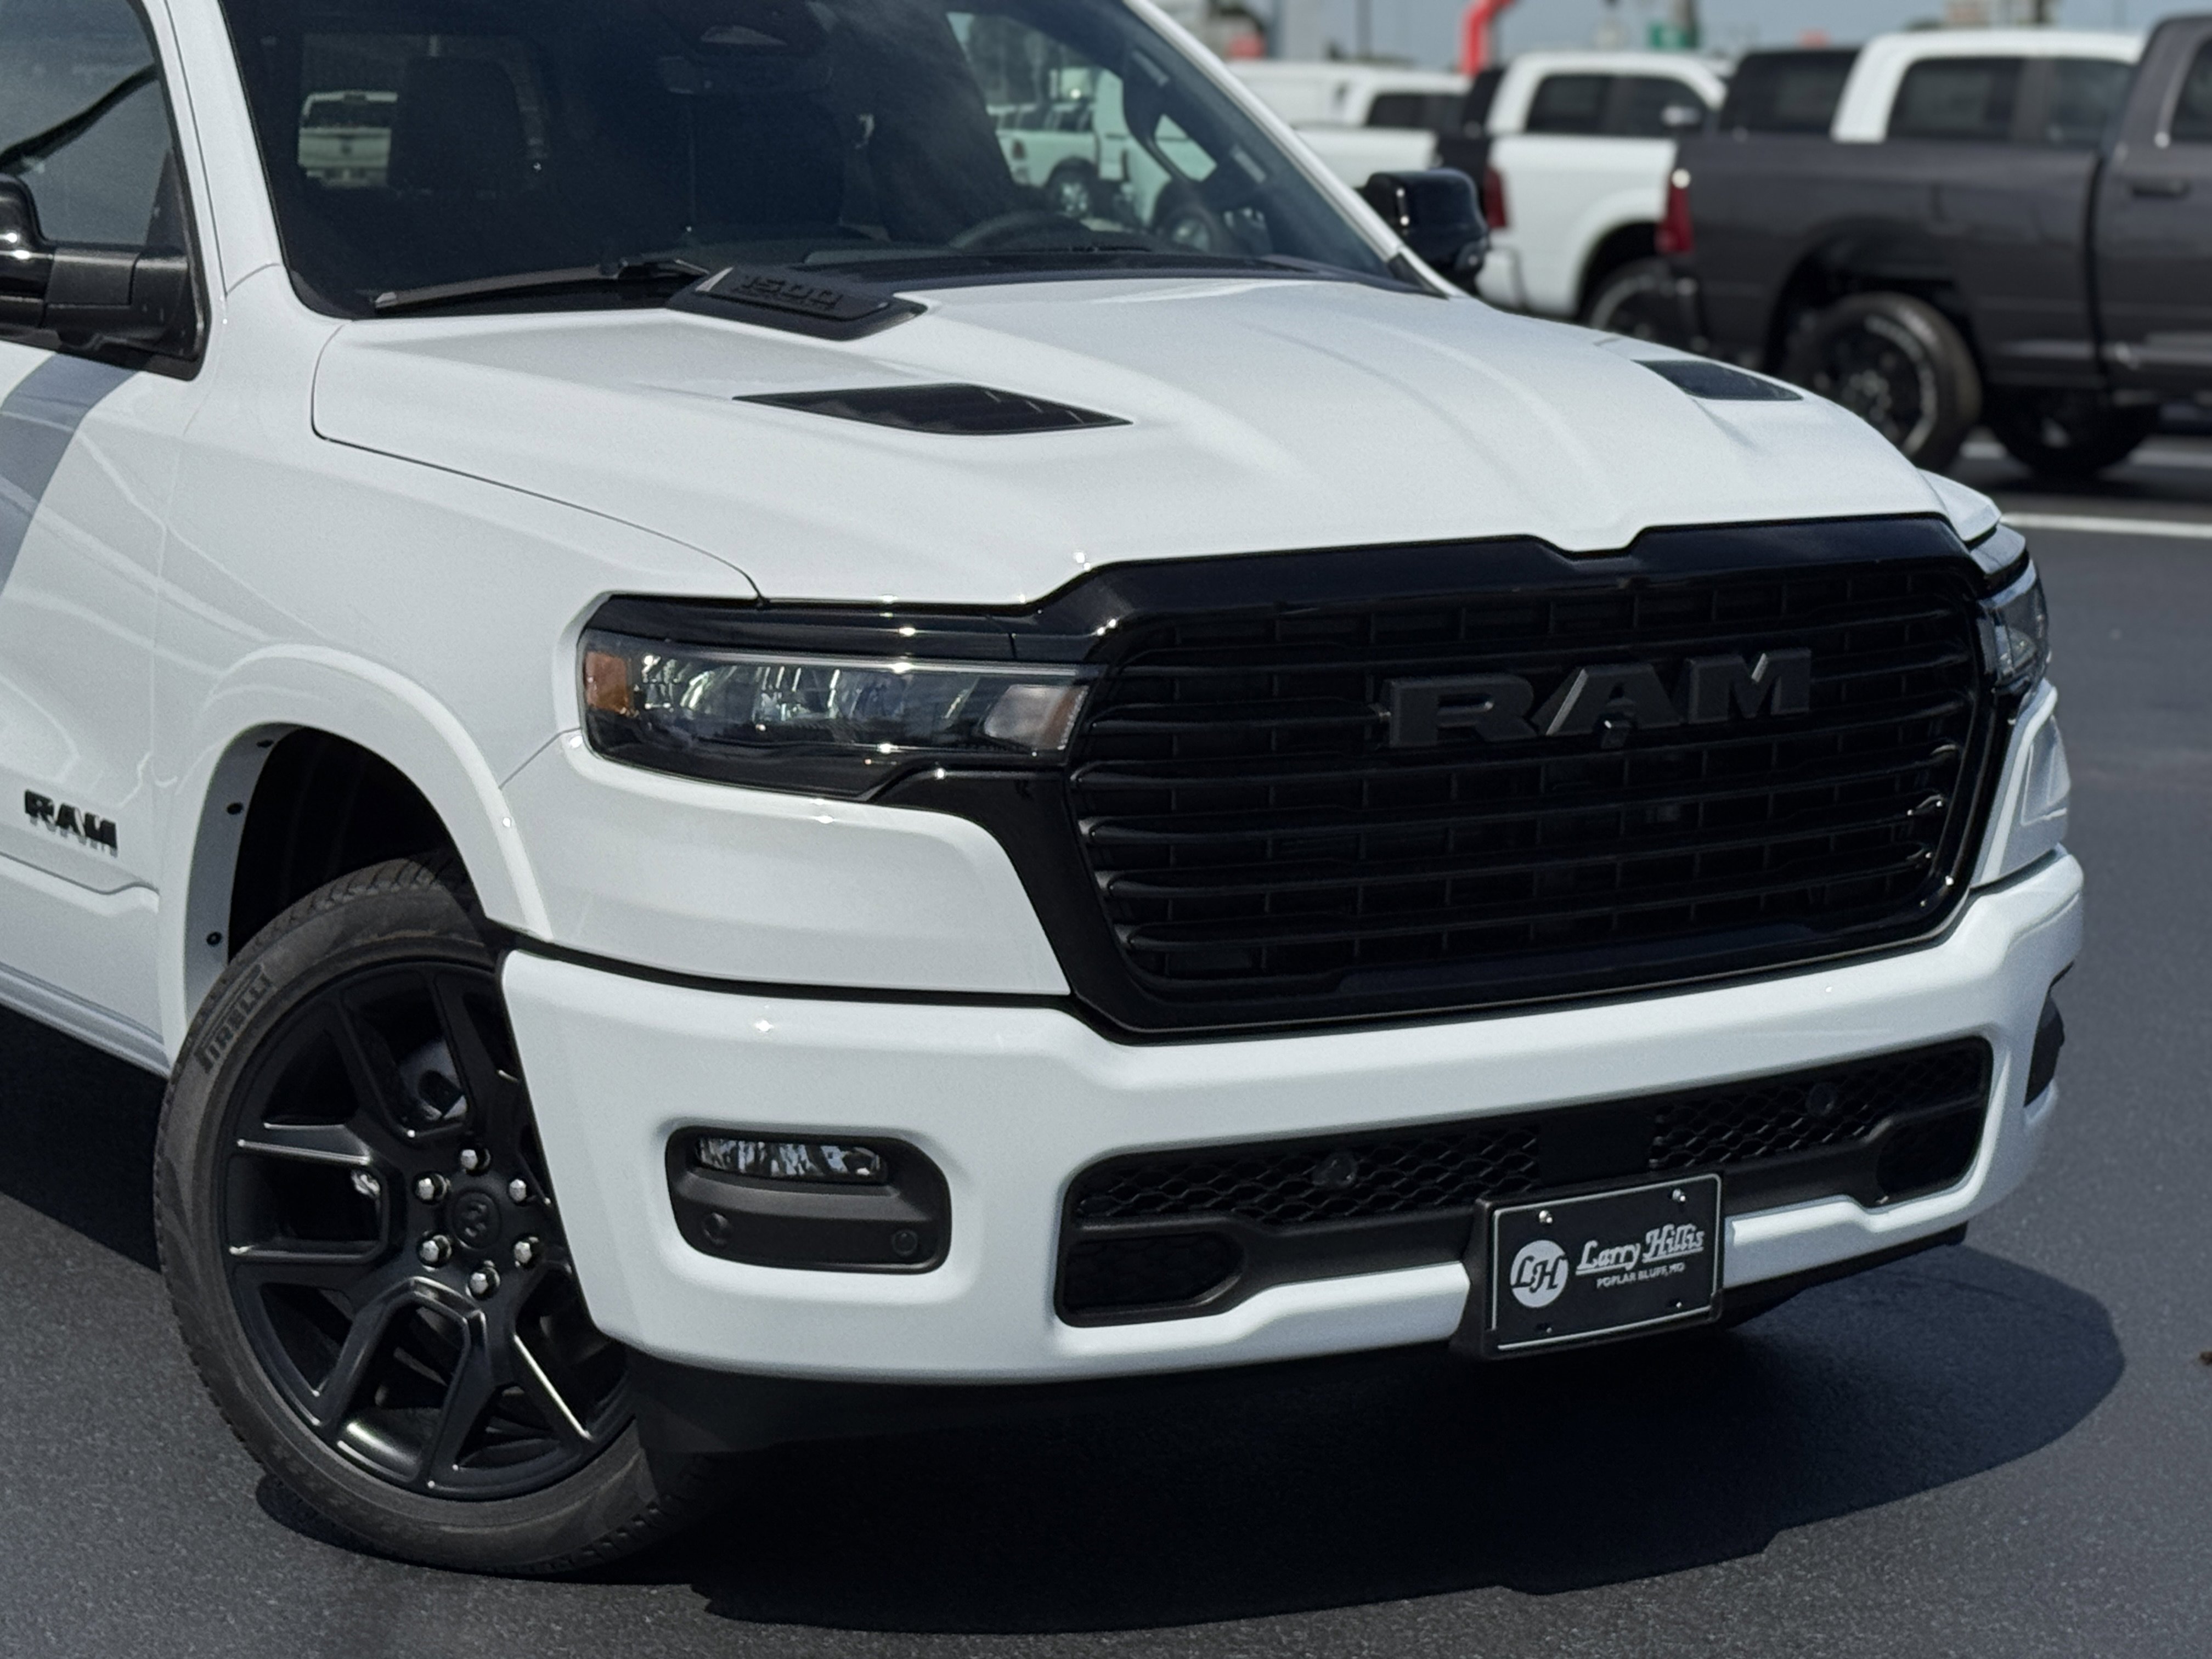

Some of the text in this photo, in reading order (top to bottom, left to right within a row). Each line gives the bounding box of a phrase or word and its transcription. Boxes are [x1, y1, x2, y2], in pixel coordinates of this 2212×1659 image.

[1387, 647, 1812, 748] RAM
[24, 789, 117, 849] RAM
[193, 963, 274, 1074] PIRELLI
[1511, 1254, 1568, 1294] LH
[1576, 1224, 1705, 1273] Larry Hillis
[1596, 1272, 1637, 1288] POPLAR
[1668, 1262, 1685, 1274] MO
